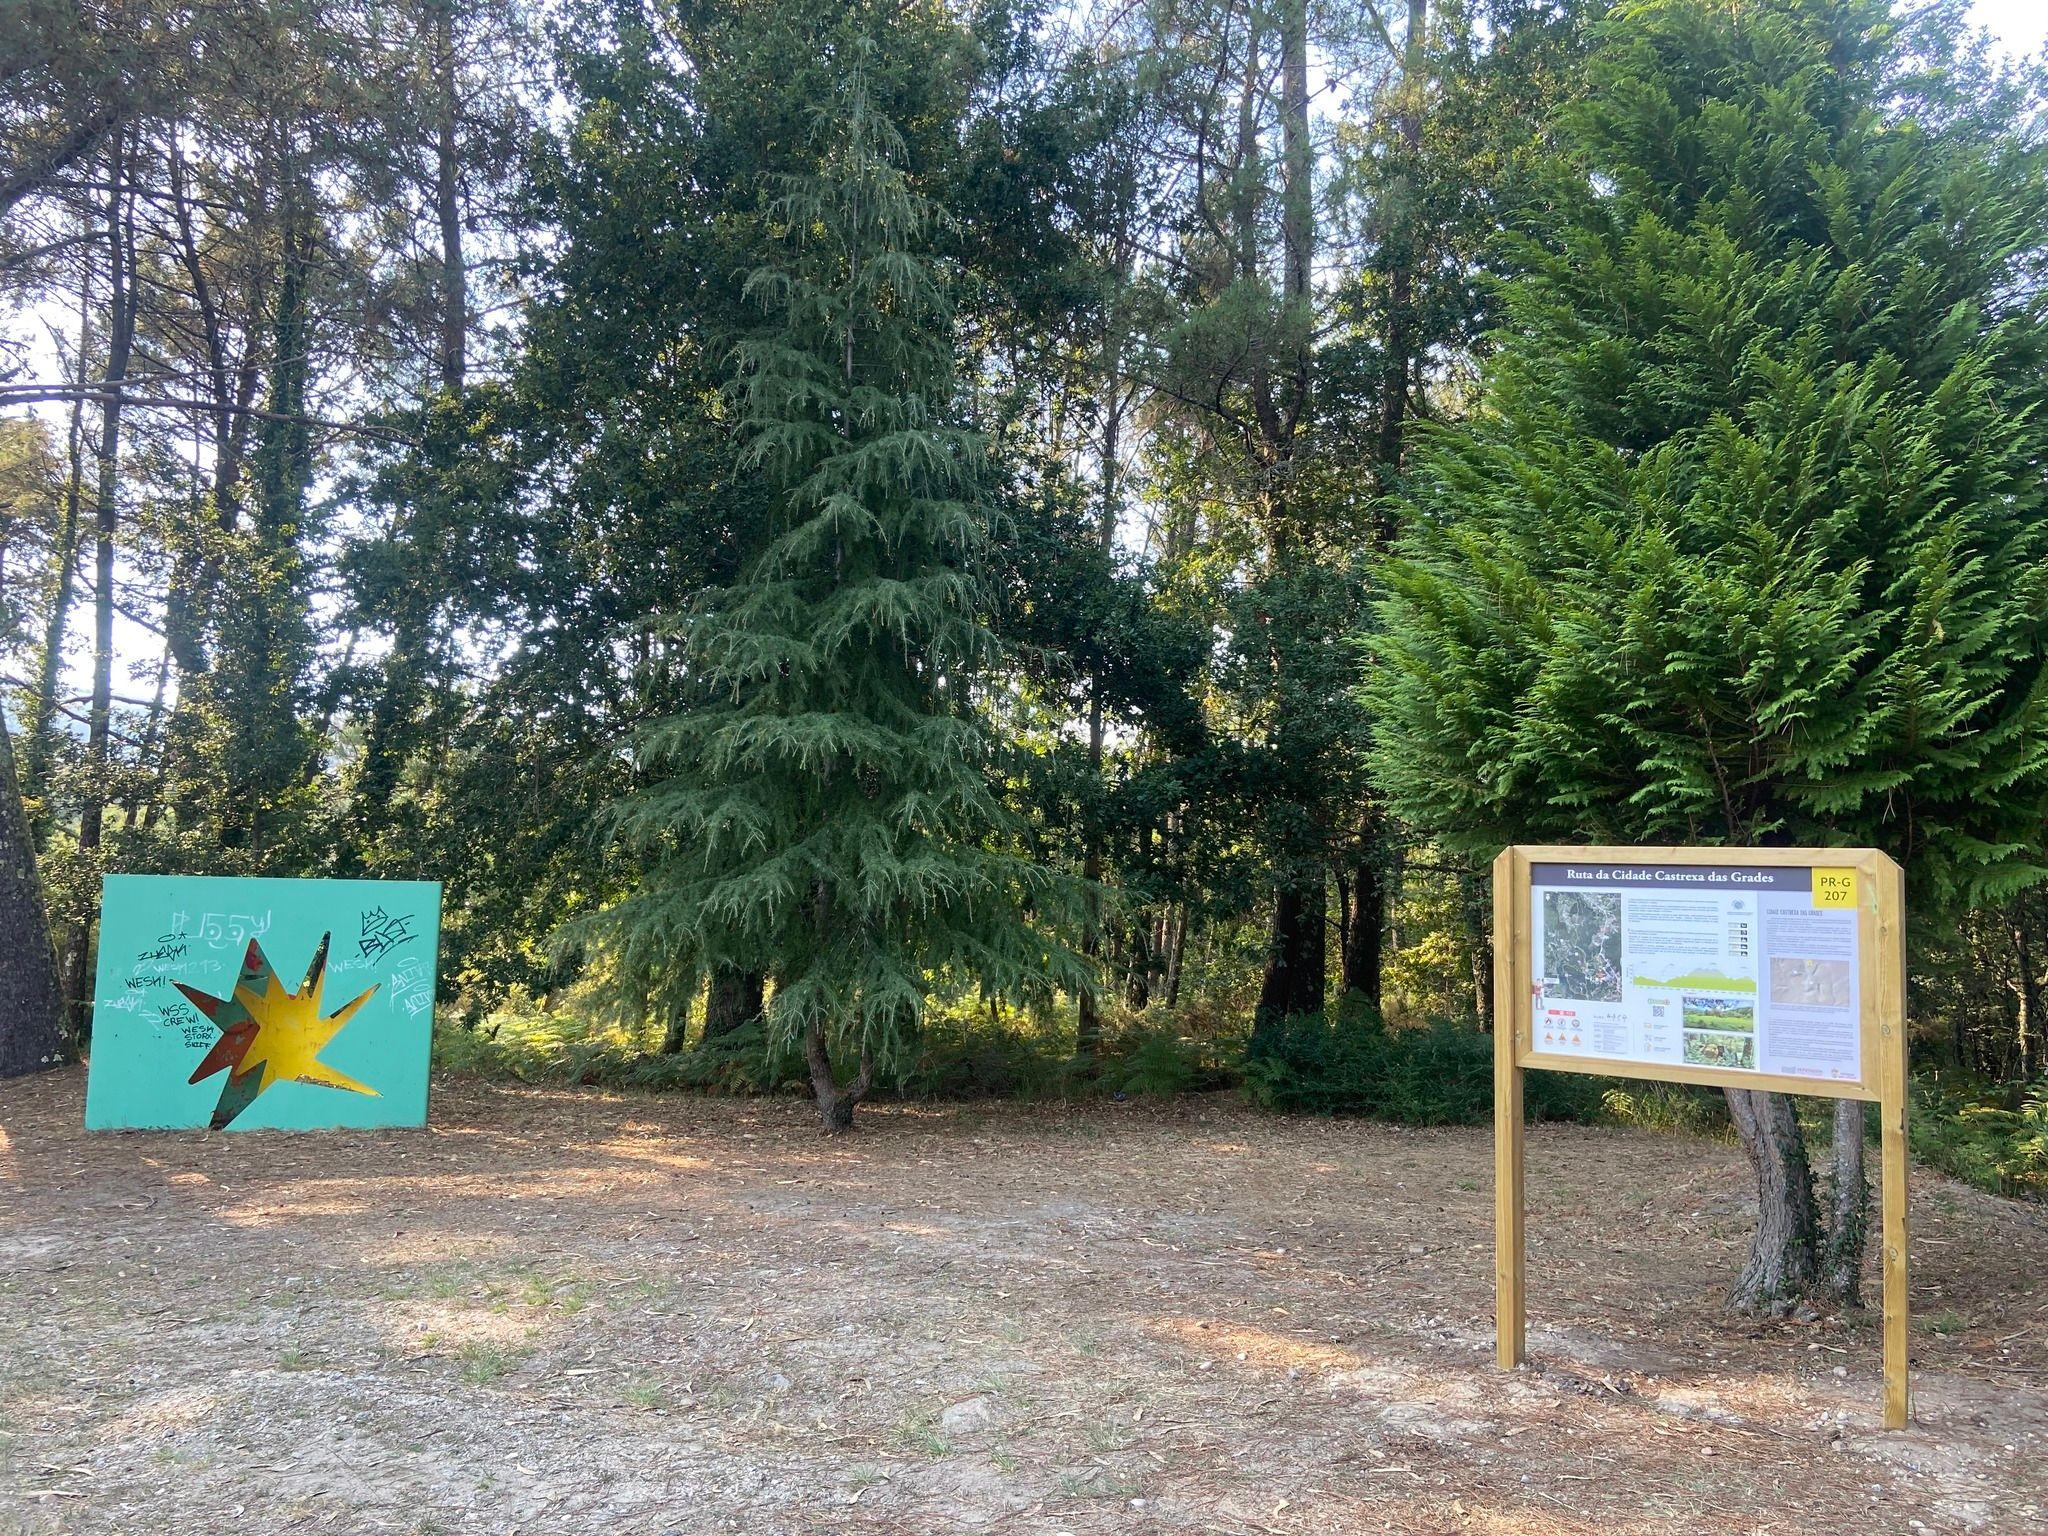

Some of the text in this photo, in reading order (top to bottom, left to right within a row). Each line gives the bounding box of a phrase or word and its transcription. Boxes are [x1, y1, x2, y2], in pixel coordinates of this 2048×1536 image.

[1567, 870, 1774, 883] Ruta da Cidade Castrexa das Grades
[1820, 877, 1851, 887] PR-G
[1824, 891, 1847, 901] 207
